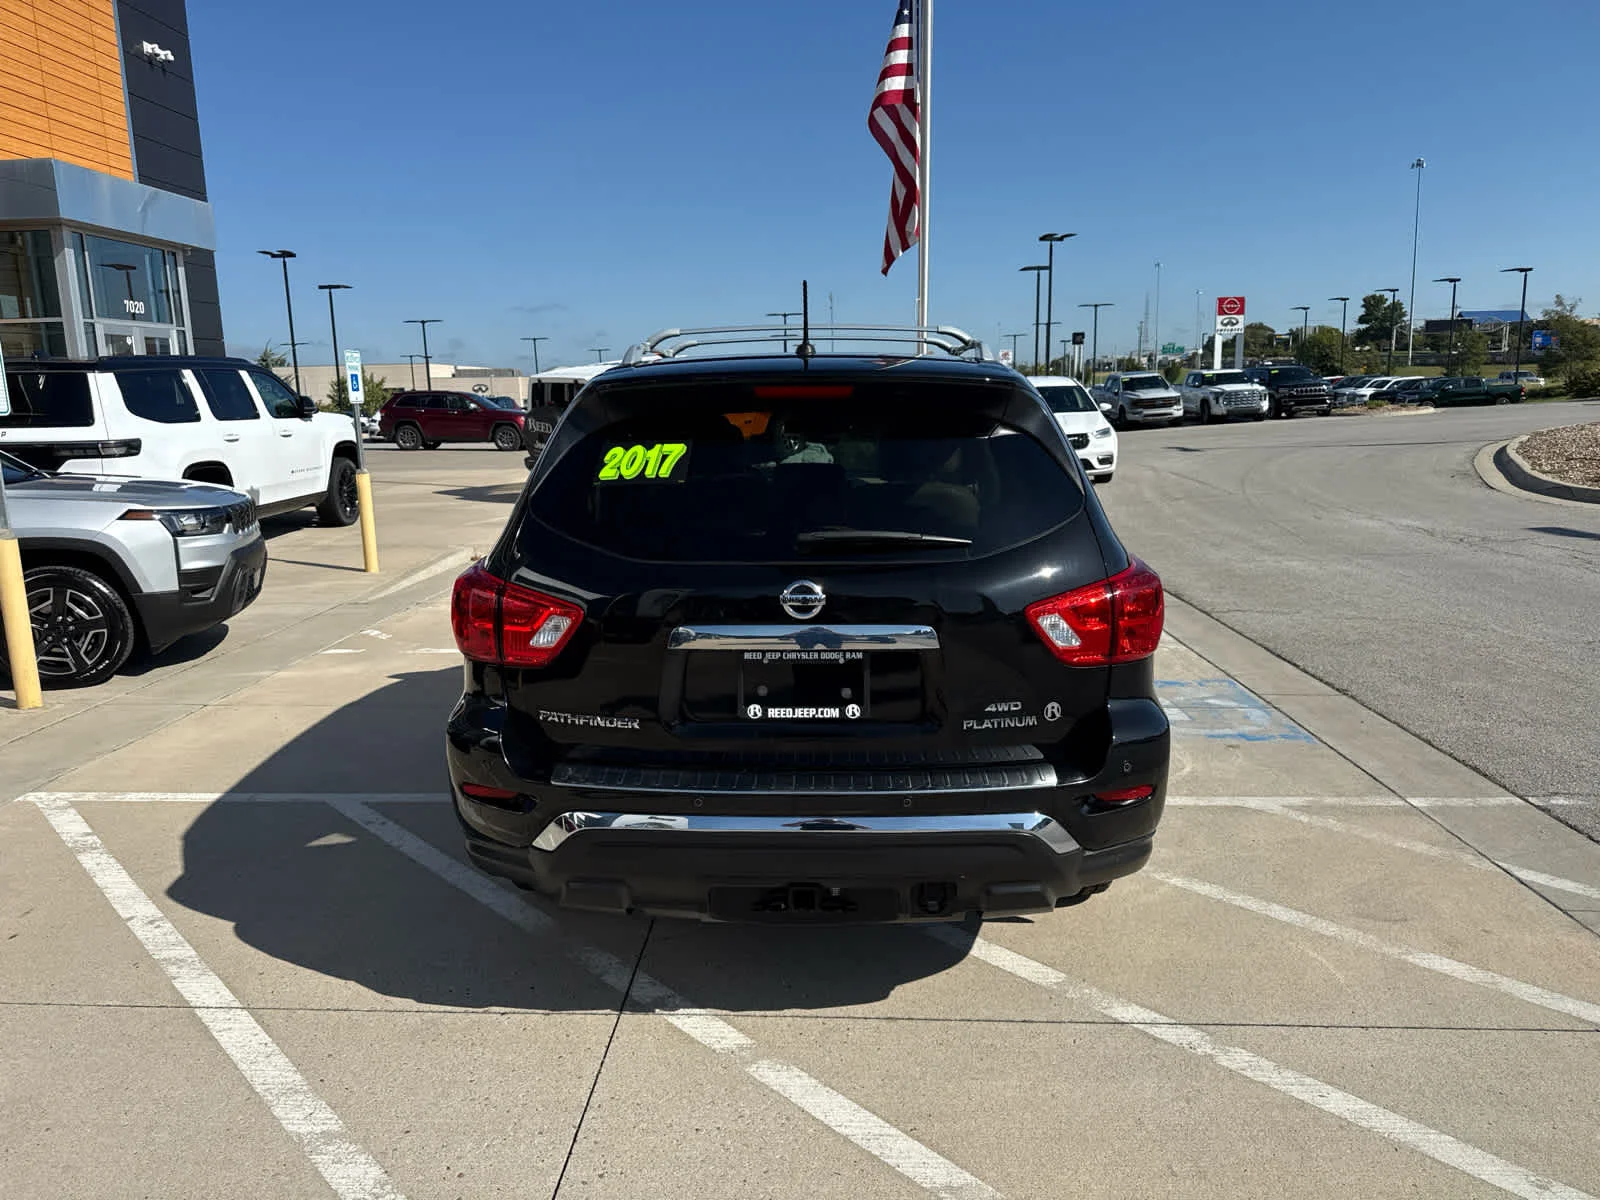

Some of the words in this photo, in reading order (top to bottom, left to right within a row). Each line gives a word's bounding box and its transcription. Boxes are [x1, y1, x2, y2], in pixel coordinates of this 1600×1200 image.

[123, 299, 145, 314] 7020
[527, 417, 553, 434] REED
[598, 443, 688, 480] 2017
[780, 594, 825, 605] NISSAN
[743, 651, 763, 660] REED
[765, 651, 781, 660] JEEP
[782, 651, 819, 660] CHRYSLER
[820, 651, 844, 660] DODGE
[845, 651, 863, 659] RAM
[767, 707, 840, 718] REEDJEEP.COM
[984, 701, 1022, 712] 4WD
[538, 710, 641, 729] PATHFINDER
[962, 715, 1038, 730] PLATINUM
